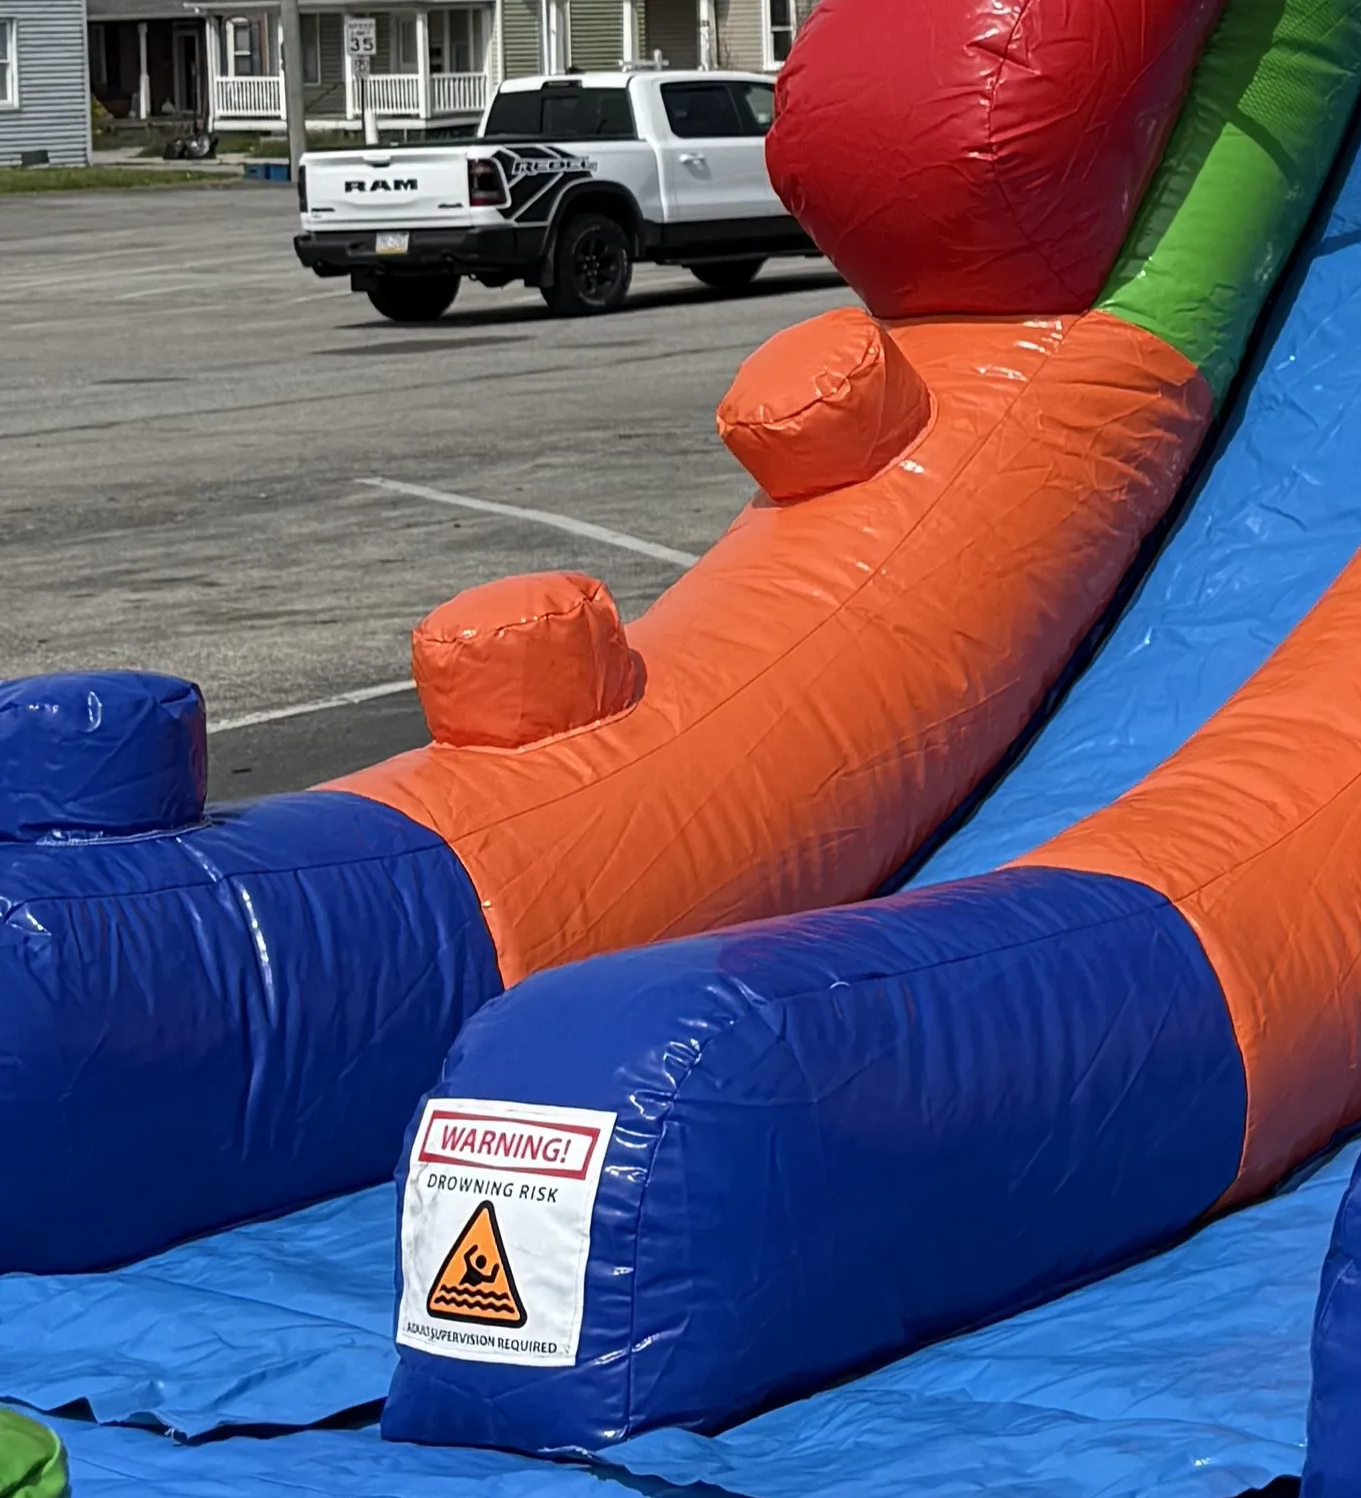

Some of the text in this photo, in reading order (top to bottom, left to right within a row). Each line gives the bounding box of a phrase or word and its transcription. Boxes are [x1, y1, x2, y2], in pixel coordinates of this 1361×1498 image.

[350, 37, 374, 52] 35
[344, 178, 418, 193] RAM
[440, 1124, 572, 1164] WARNING!
[426, 1173, 559, 1203] DROWNING RISK
[430, 1327, 495, 1347] SUPERVISION
[497, 1336, 558, 1353] REQUIRED
